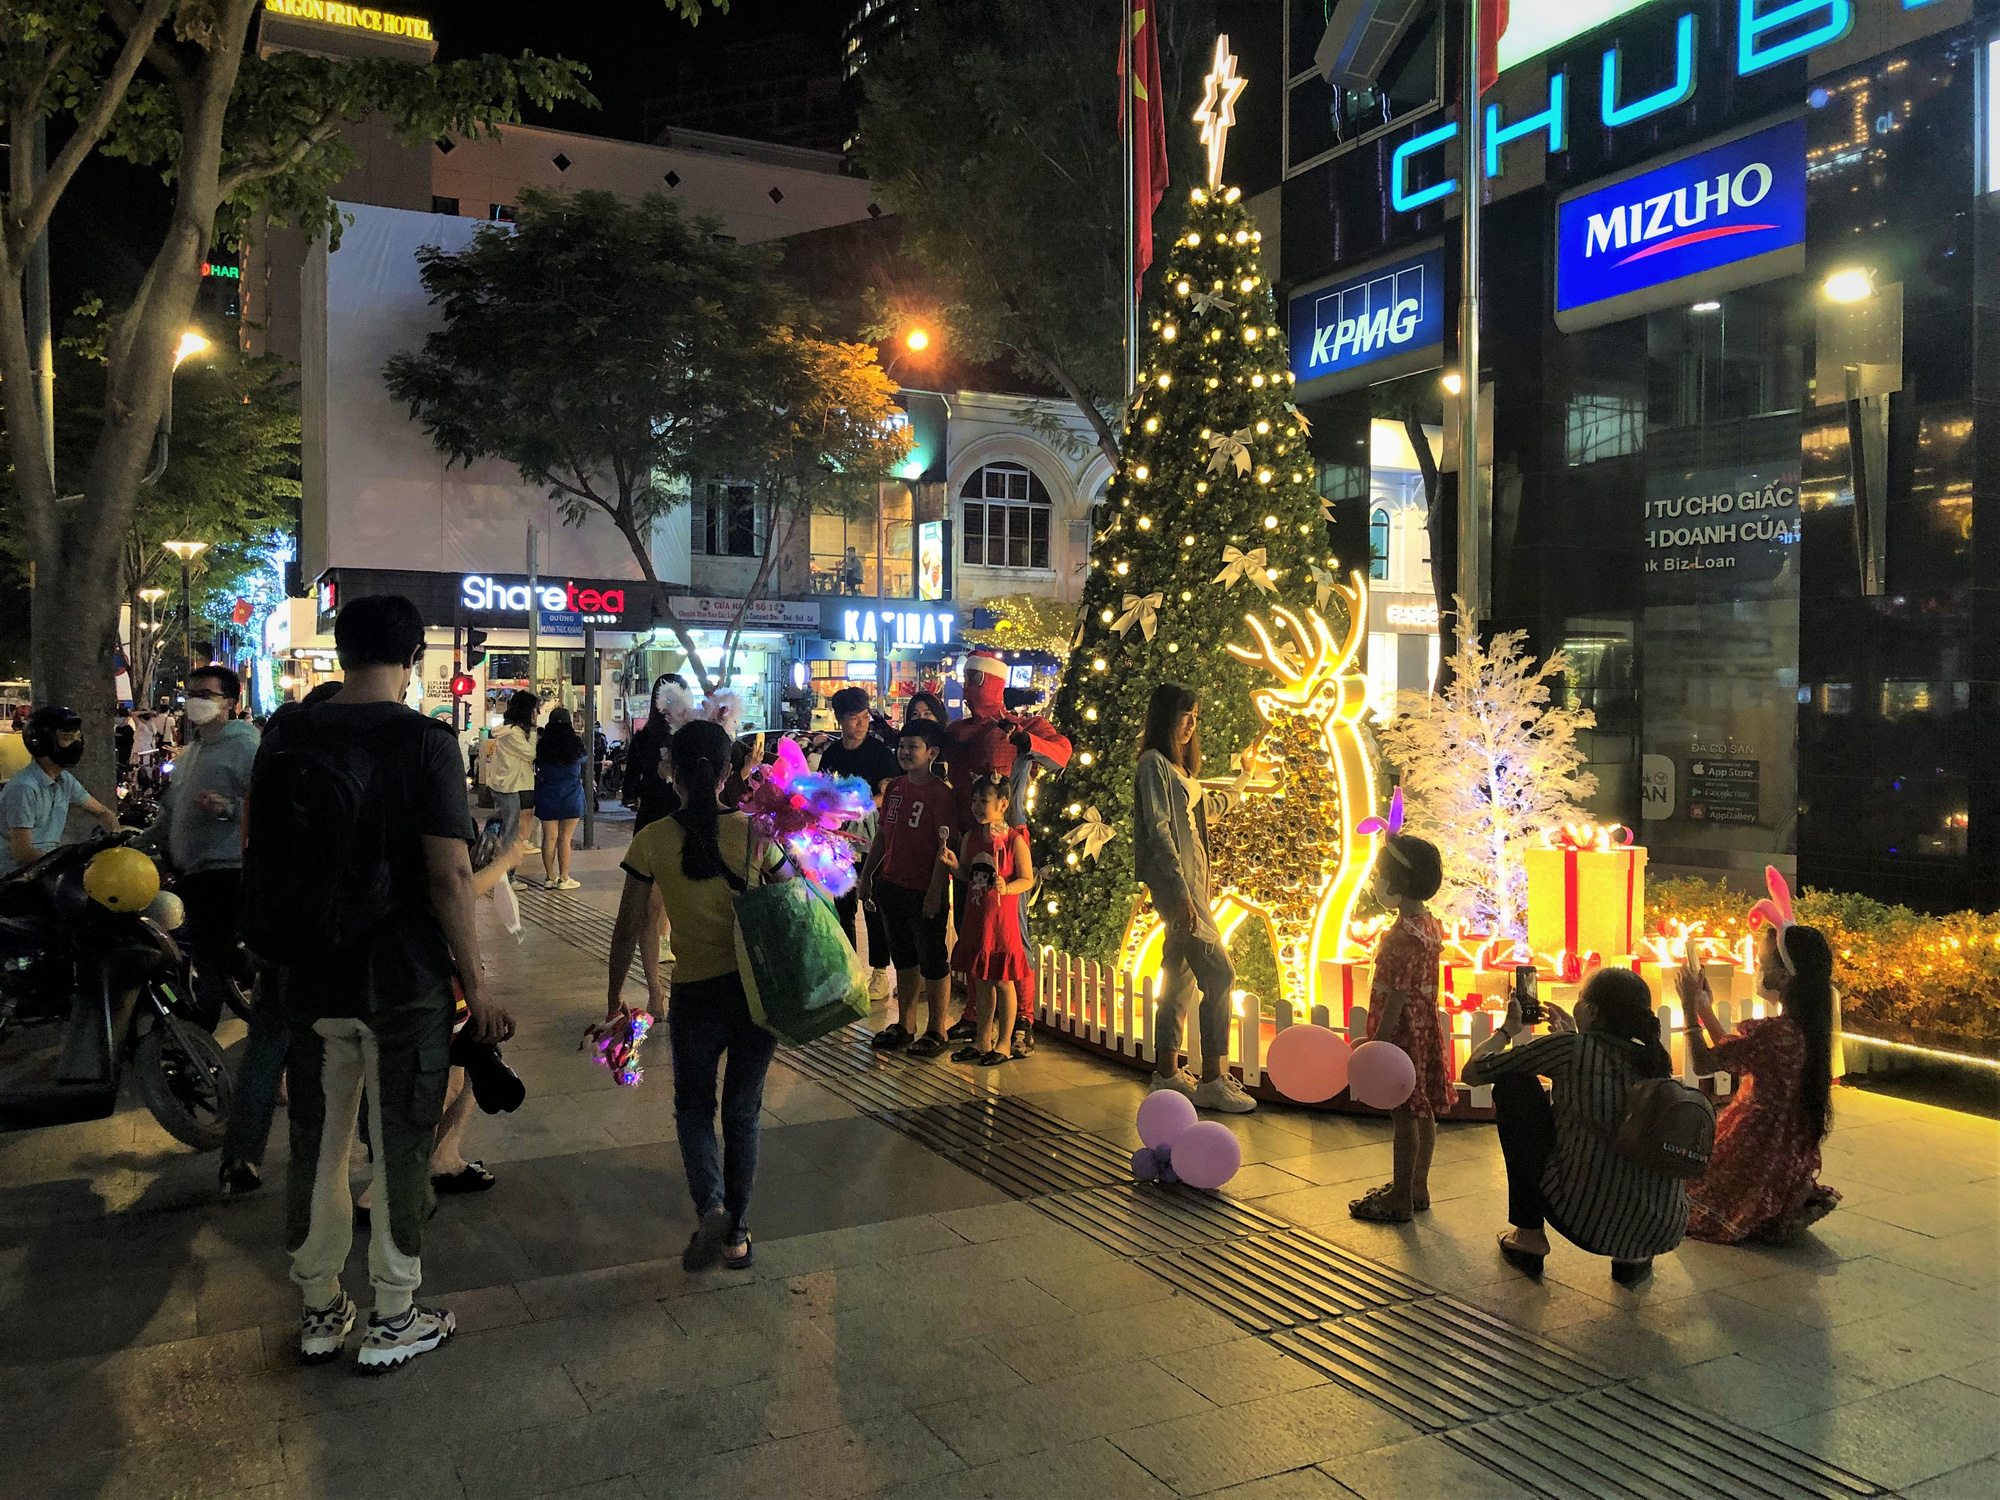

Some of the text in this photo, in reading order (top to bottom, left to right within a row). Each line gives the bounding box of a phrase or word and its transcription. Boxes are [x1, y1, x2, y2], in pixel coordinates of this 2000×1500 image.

[265, 0, 433, 41] SAIGON PRINCE HOTEL
[1392, 0, 1932, 212] CHUB
[1585, 162, 1773, 258] MIZUHO
[1309, 298, 1418, 368] KPMG
[1654, 496, 1685, 518] TƯ
[1686, 494, 1733, 515] CHO
[1737, 479, 1794, 511] GIẤC
[1659, 524, 1736, 548] DOANH
[1740, 514, 1788, 541] CỦA
[1664, 558, 1689, 571] Biz
[1695, 556, 1735, 569] Loan
[1708, 768, 1754, 778] App Store
[908, 800, 924, 828] 3
